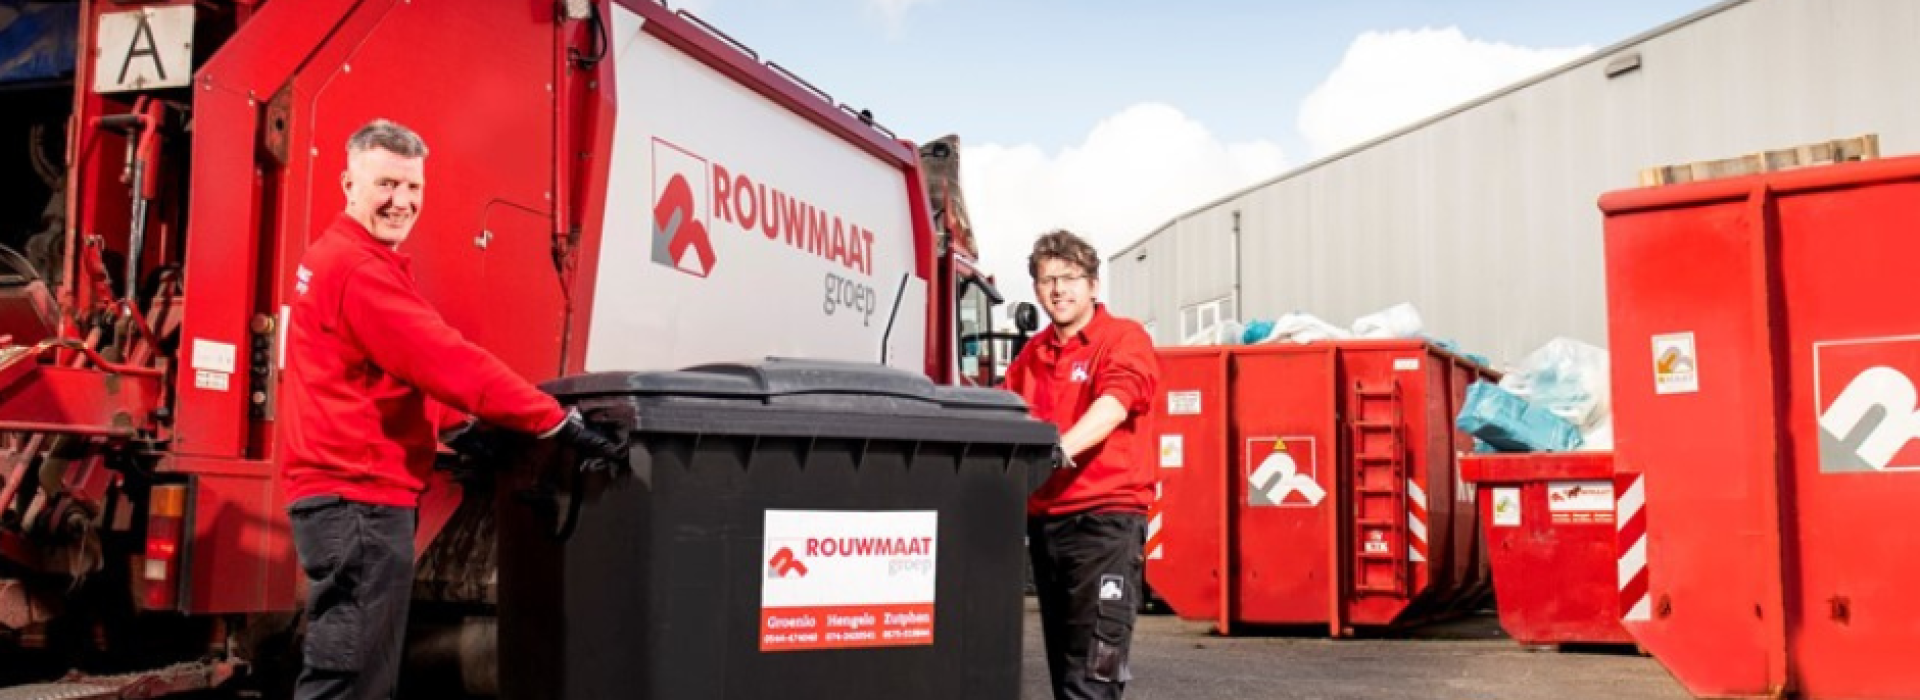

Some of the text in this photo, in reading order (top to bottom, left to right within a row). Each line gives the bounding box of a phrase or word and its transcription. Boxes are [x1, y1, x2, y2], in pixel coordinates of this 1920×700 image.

[117, 14, 167, 85] A
[712, 162, 874, 277] ROUWMAAT
[822, 271, 877, 328] groep
[805, 537, 932, 557] ROUWMAAT
[888, 559, 932, 577] groep
[768, 610, 930, 629] Groenlo Hengelo Zutphen
